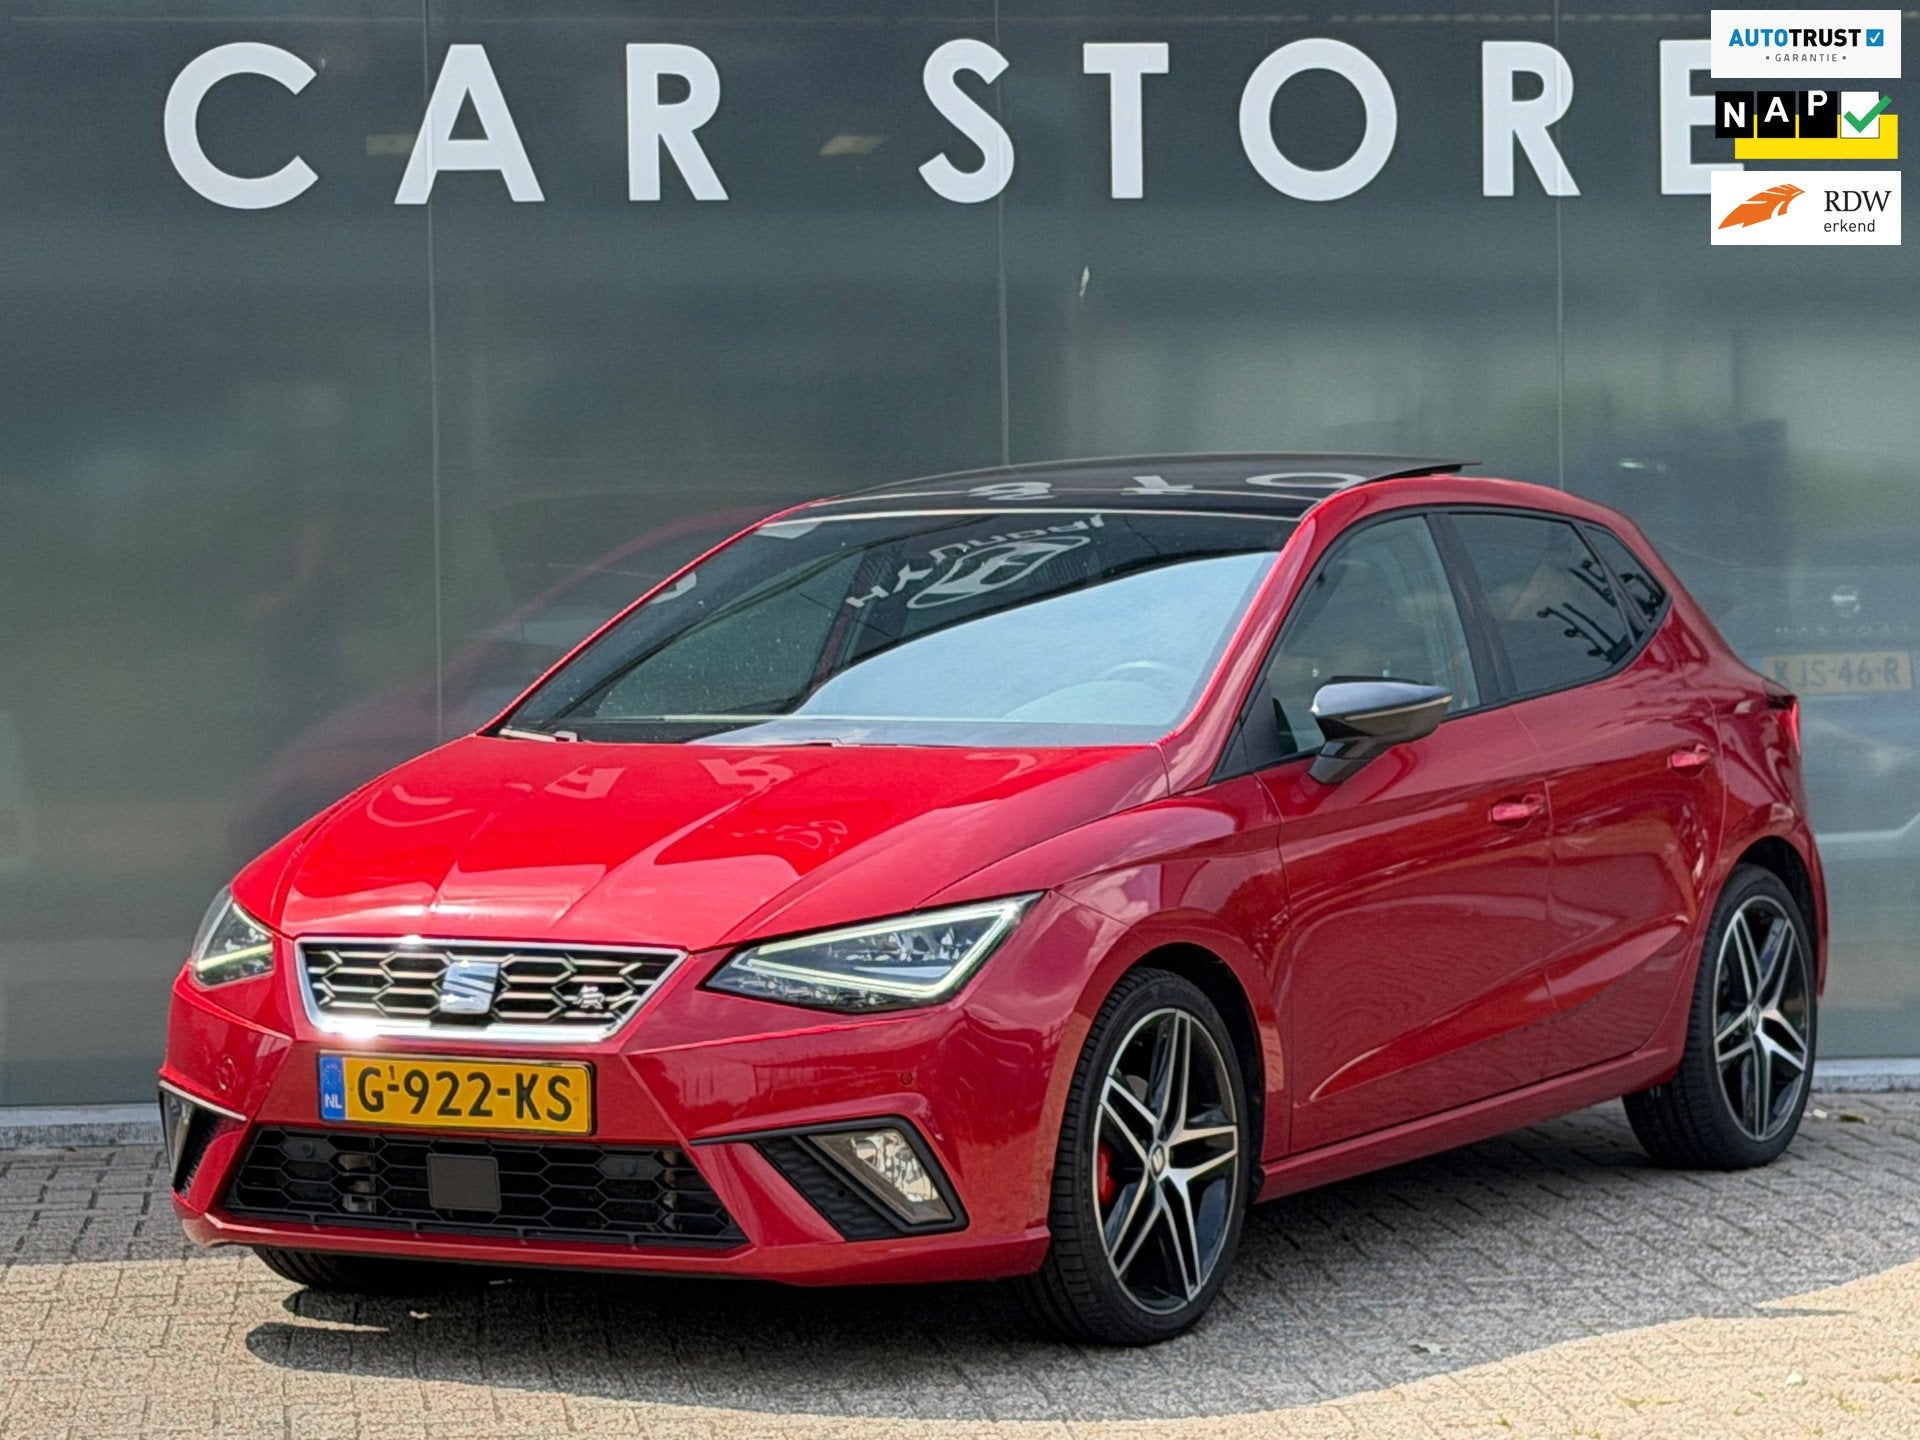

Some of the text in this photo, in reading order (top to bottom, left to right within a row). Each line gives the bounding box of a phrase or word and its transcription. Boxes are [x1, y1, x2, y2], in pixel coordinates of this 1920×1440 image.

[163, 37, 1745, 210] CAR STORE
[324, 1093, 343, 1109] NL
[356, 1065, 573, 1122] G-922-KS
